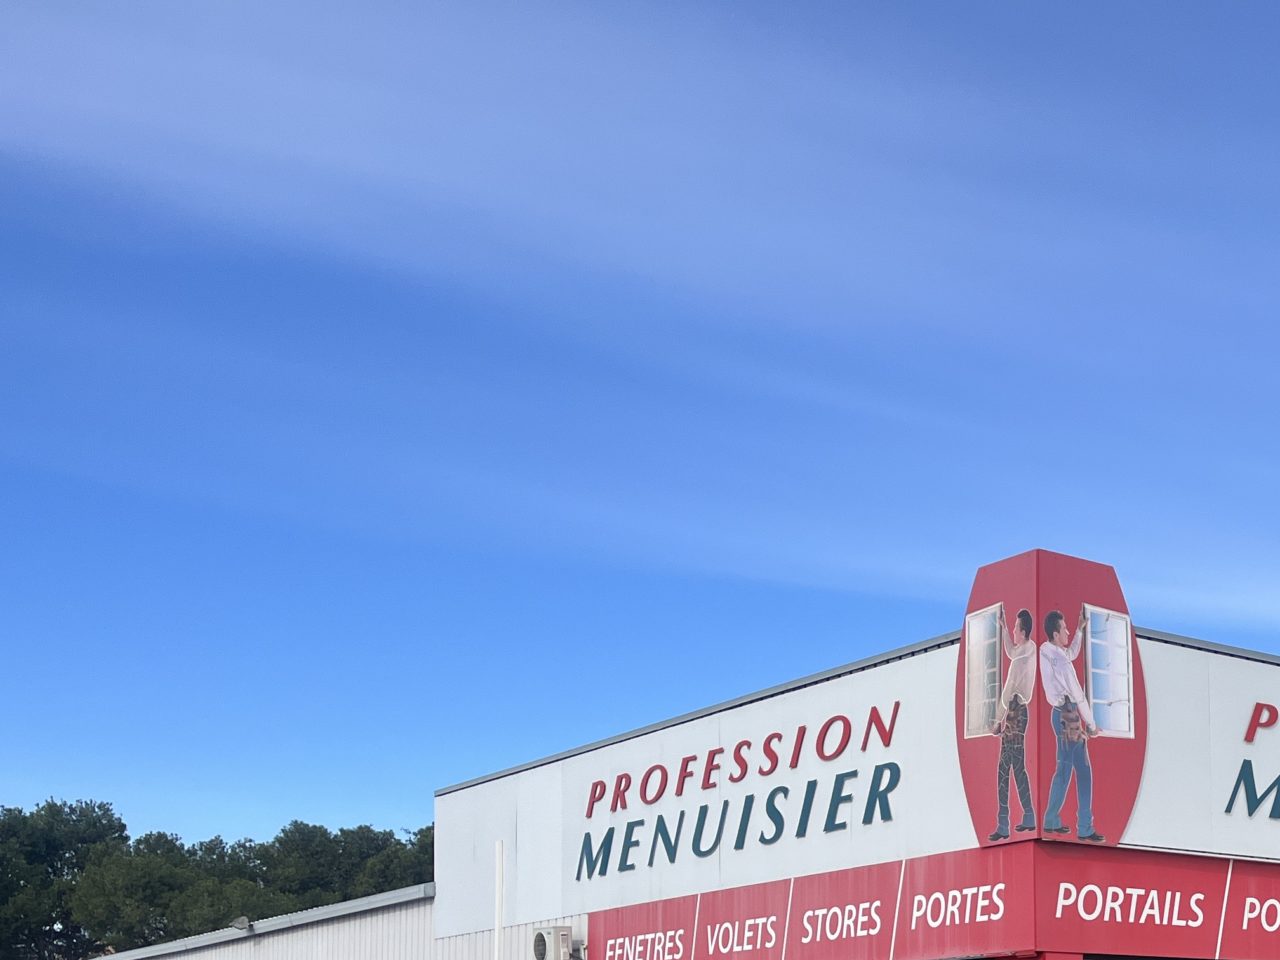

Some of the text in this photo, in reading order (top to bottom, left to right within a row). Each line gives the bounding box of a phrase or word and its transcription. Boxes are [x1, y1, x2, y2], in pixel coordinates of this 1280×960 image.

[585, 700, 900, 819] PROFESSION
[576, 761, 901, 882] MENUISIER
[801, 900, 881, 944] STORES
[911, 882, 1005, 930] PORTES
[1055, 882, 1205, 928] PORTAILS
[706, 915, 777, 955] VOLETS
